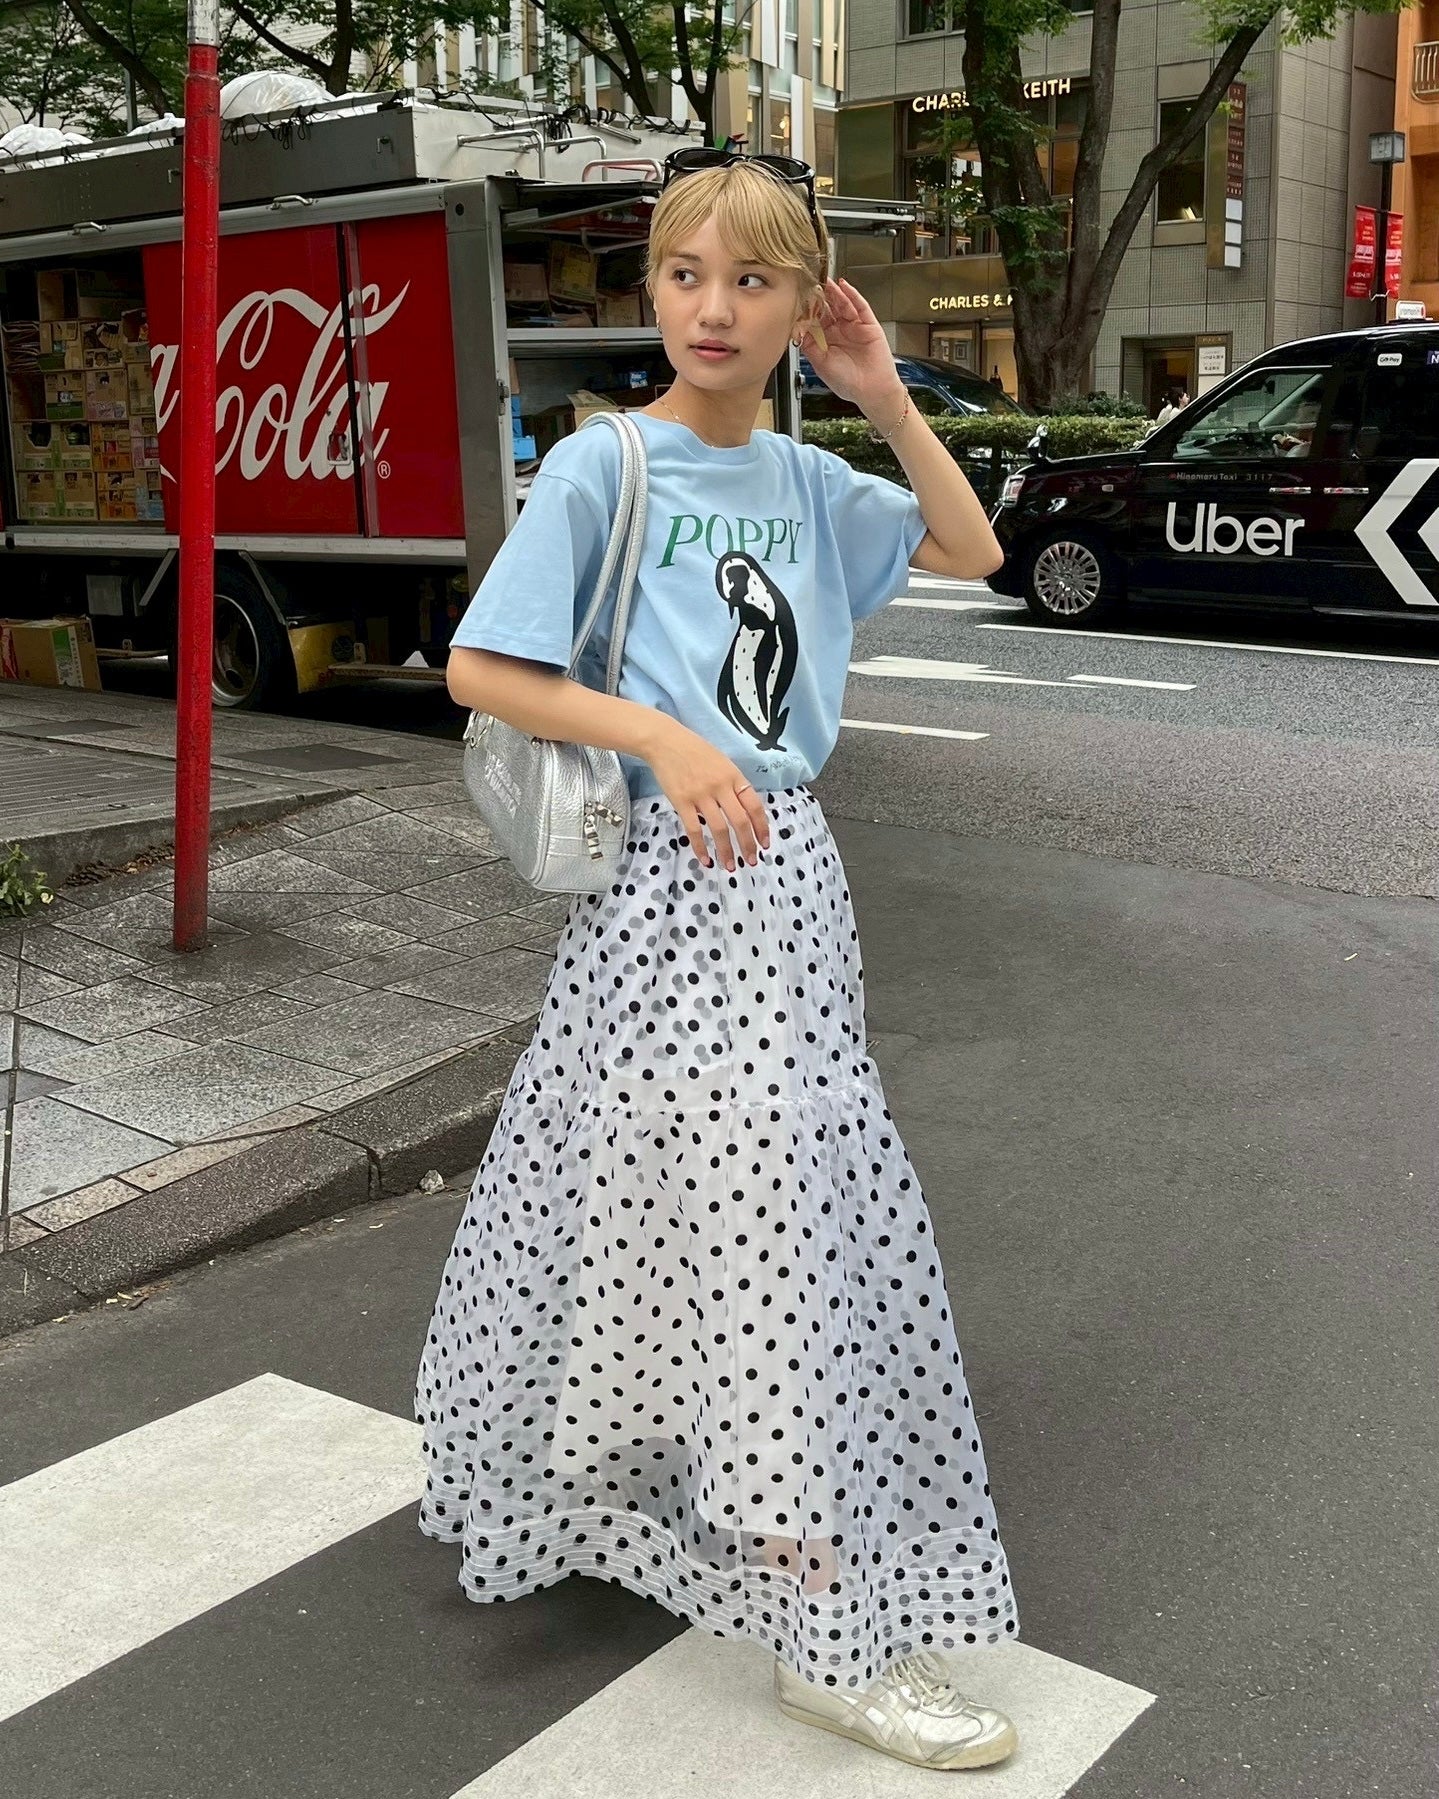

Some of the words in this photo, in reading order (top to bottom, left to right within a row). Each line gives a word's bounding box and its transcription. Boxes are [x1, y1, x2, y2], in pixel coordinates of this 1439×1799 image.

[929, 294, 989, 310] CHARLES
[993, 293, 1004, 307] &
[1176, 471, 1218, 481] Hinomaru
[1219, 472, 1238, 481] Taxi
[656, 514, 803, 569] POPPY
[1166, 502, 1305, 556] Uber
